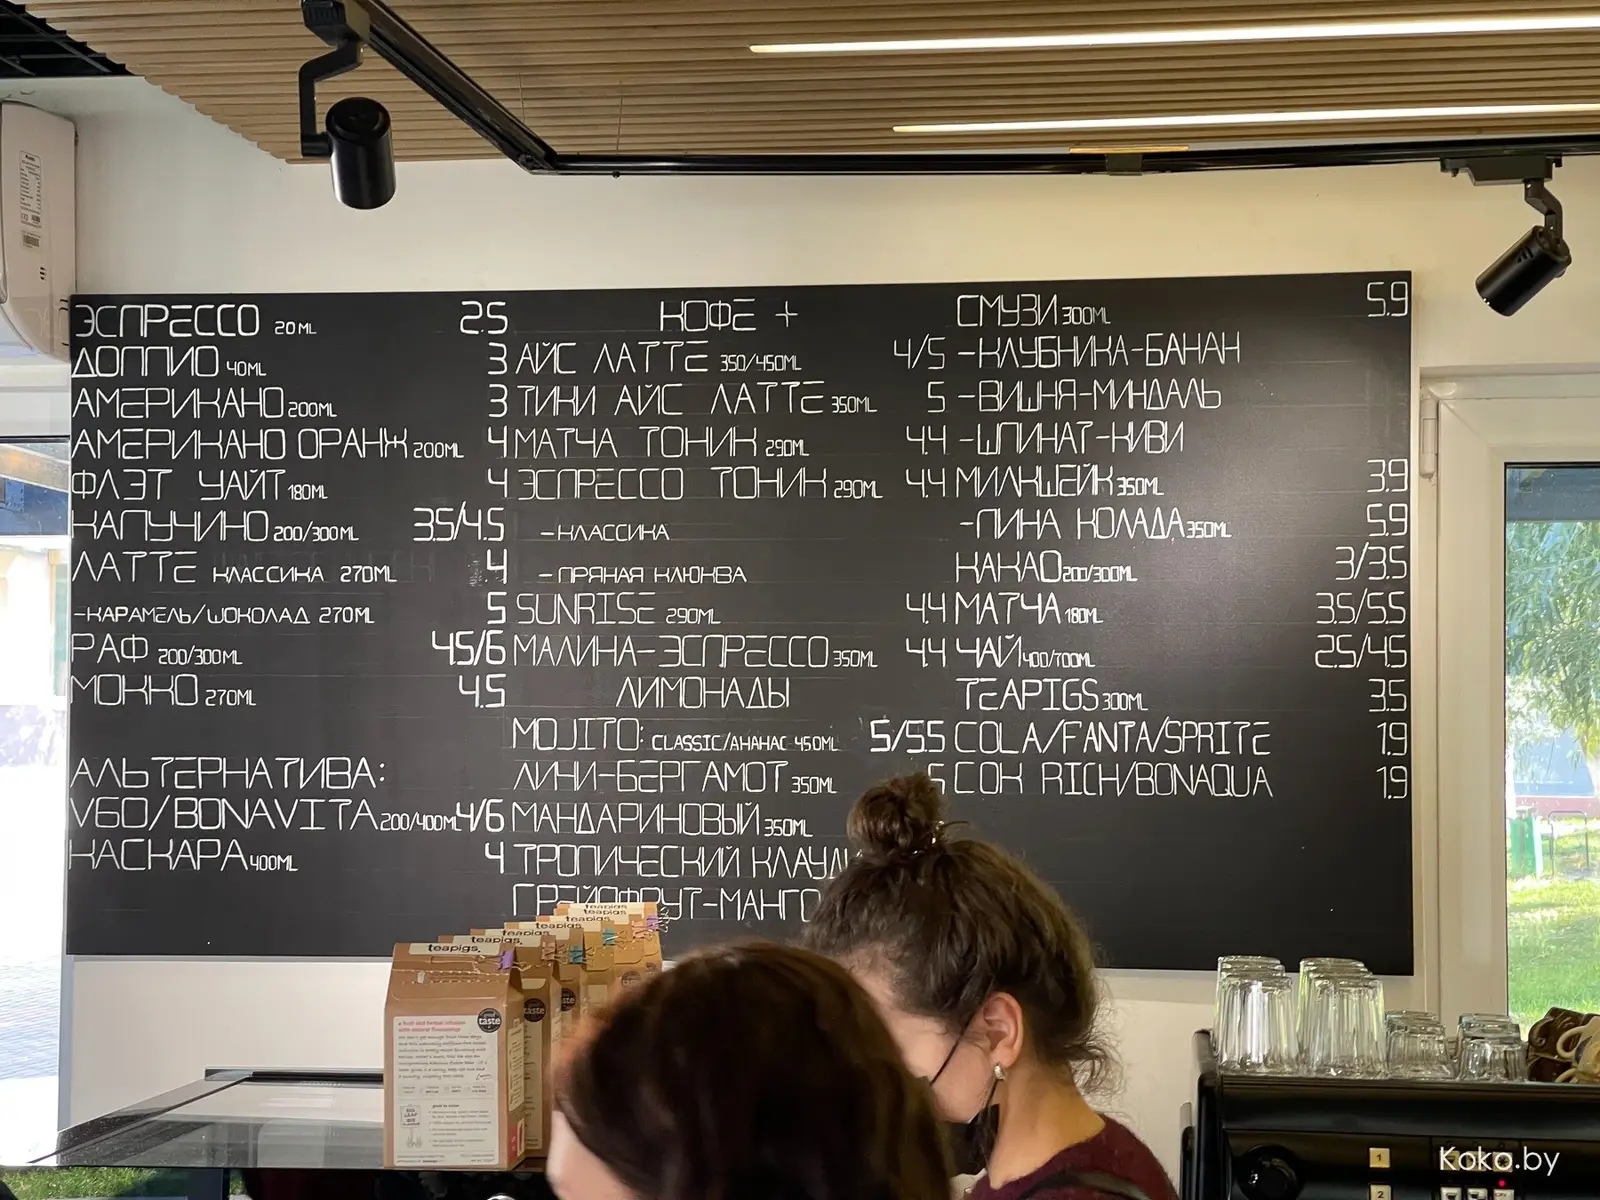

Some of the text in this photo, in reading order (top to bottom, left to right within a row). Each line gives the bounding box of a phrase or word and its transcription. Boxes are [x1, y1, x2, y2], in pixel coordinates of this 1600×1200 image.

[76, 304, 317, 338] ЭСПРЕССО 20ML
[660, 299, 756, 332] КОФЕ
[957, 294, 1111, 327] СМУЗИ 300ML
[69, 346, 266, 378] ДОППИО 40ML
[488, 342, 507, 375] 3
[516, 341, 802, 374] АЙС ЛАТТЕ 350/450ML
[894, 334, 945, 369] 4/5
[958, 331, 1240, 368] -КЛУБНИКА-БАНАН
[70, 387, 337, 421] АМЕРИКАНО 200ML
[489, 384, 508, 417] 3
[614, 383, 683, 415] АЙС
[711, 381, 824, 415] ЛАТТЕ
[831, 396, 878, 413] 350ML
[928, 381, 945, 413] 5
[958, 378, 1221, 412] -ВИШНЯ-МИНДАЛЬ
[69, 426, 464, 460] АМЕРИКАНО ОРАНЖ 200ML
[488, 426, 507, 458] 4
[515, 426, 809, 459] МАТЧА ТОНИК 290ML
[959, 420, 1183, 455] -ШПИНАТ-КИВИ
[69, 467, 328, 503] ФЛЭТ УАЙТ 180ML
[488, 468, 508, 498] 4
[518, 466, 883, 500] ЭСПРЕССО ТОНИК 290ML
[956, 463, 1164, 498] МИЛКШЕЙК 350ML
[69, 507, 359, 544] КАПУЧИНО 200/300ML
[1077, 507, 1185, 540] КОЛАДА
[1187, 521, 1232, 538] 350ML
[69, 549, 397, 584] ЛАТТЕ КЛАССИКА 270ML
[487, 549, 507, 584] 4
[654, 566, 747, 584] КЛЮКВА
[956, 550, 1138, 584] КАКАО 200/300ML
[74, 604, 375, 624] -КАРАМЕЛЬ/ШОКОЛАД 270ML
[487, 592, 507, 624] 5
[517, 592, 721, 624] SUNRISE 290ML
[955, 592, 1103, 625] МАТЧА 180ML
[72, 633, 243, 665] РАФ 200/300ML
[514, 635, 878, 668] МАЛИНА-ЭСПРЕССО 350ML
[956, 634, 1096, 668] ЧАЙ 400/700ML
[205, 689, 256, 706] 270ML
[616, 676, 789, 709] ЛИМОНАДЫ
[956, 678, 1148, 711] TEAPIGS 300ML
[513, 717, 643, 751] MOJITO:
[795, 736, 841, 751] 450ML
[955, 716, 1270, 755] COLA/FANTA/SPRITE
[72, 757, 384, 789] АЛЬТЕРНАТИВА:
[791, 776, 837, 794] 350ML
[1042, 761, 1273, 797] RICH/BONAQUA
[380, 810, 461, 831] 200/400ML
[456, 798, 504, 832] 4/6
[512, 802, 813, 837] МАНДАРИНОВЫЙ 350ML
[69, 839, 298, 871] КАСКАРА 400ML
[485, 841, 504, 874] 4
[513, 844, 740, 877] ТРОПИЧЕСКИЙ
[428, 944, 481, 953] teapigs.
[479, 1017, 501, 1025] taste
[1376, 1153, 1382, 1162] 1
[1377, 1191, 1384, 1199] 2
